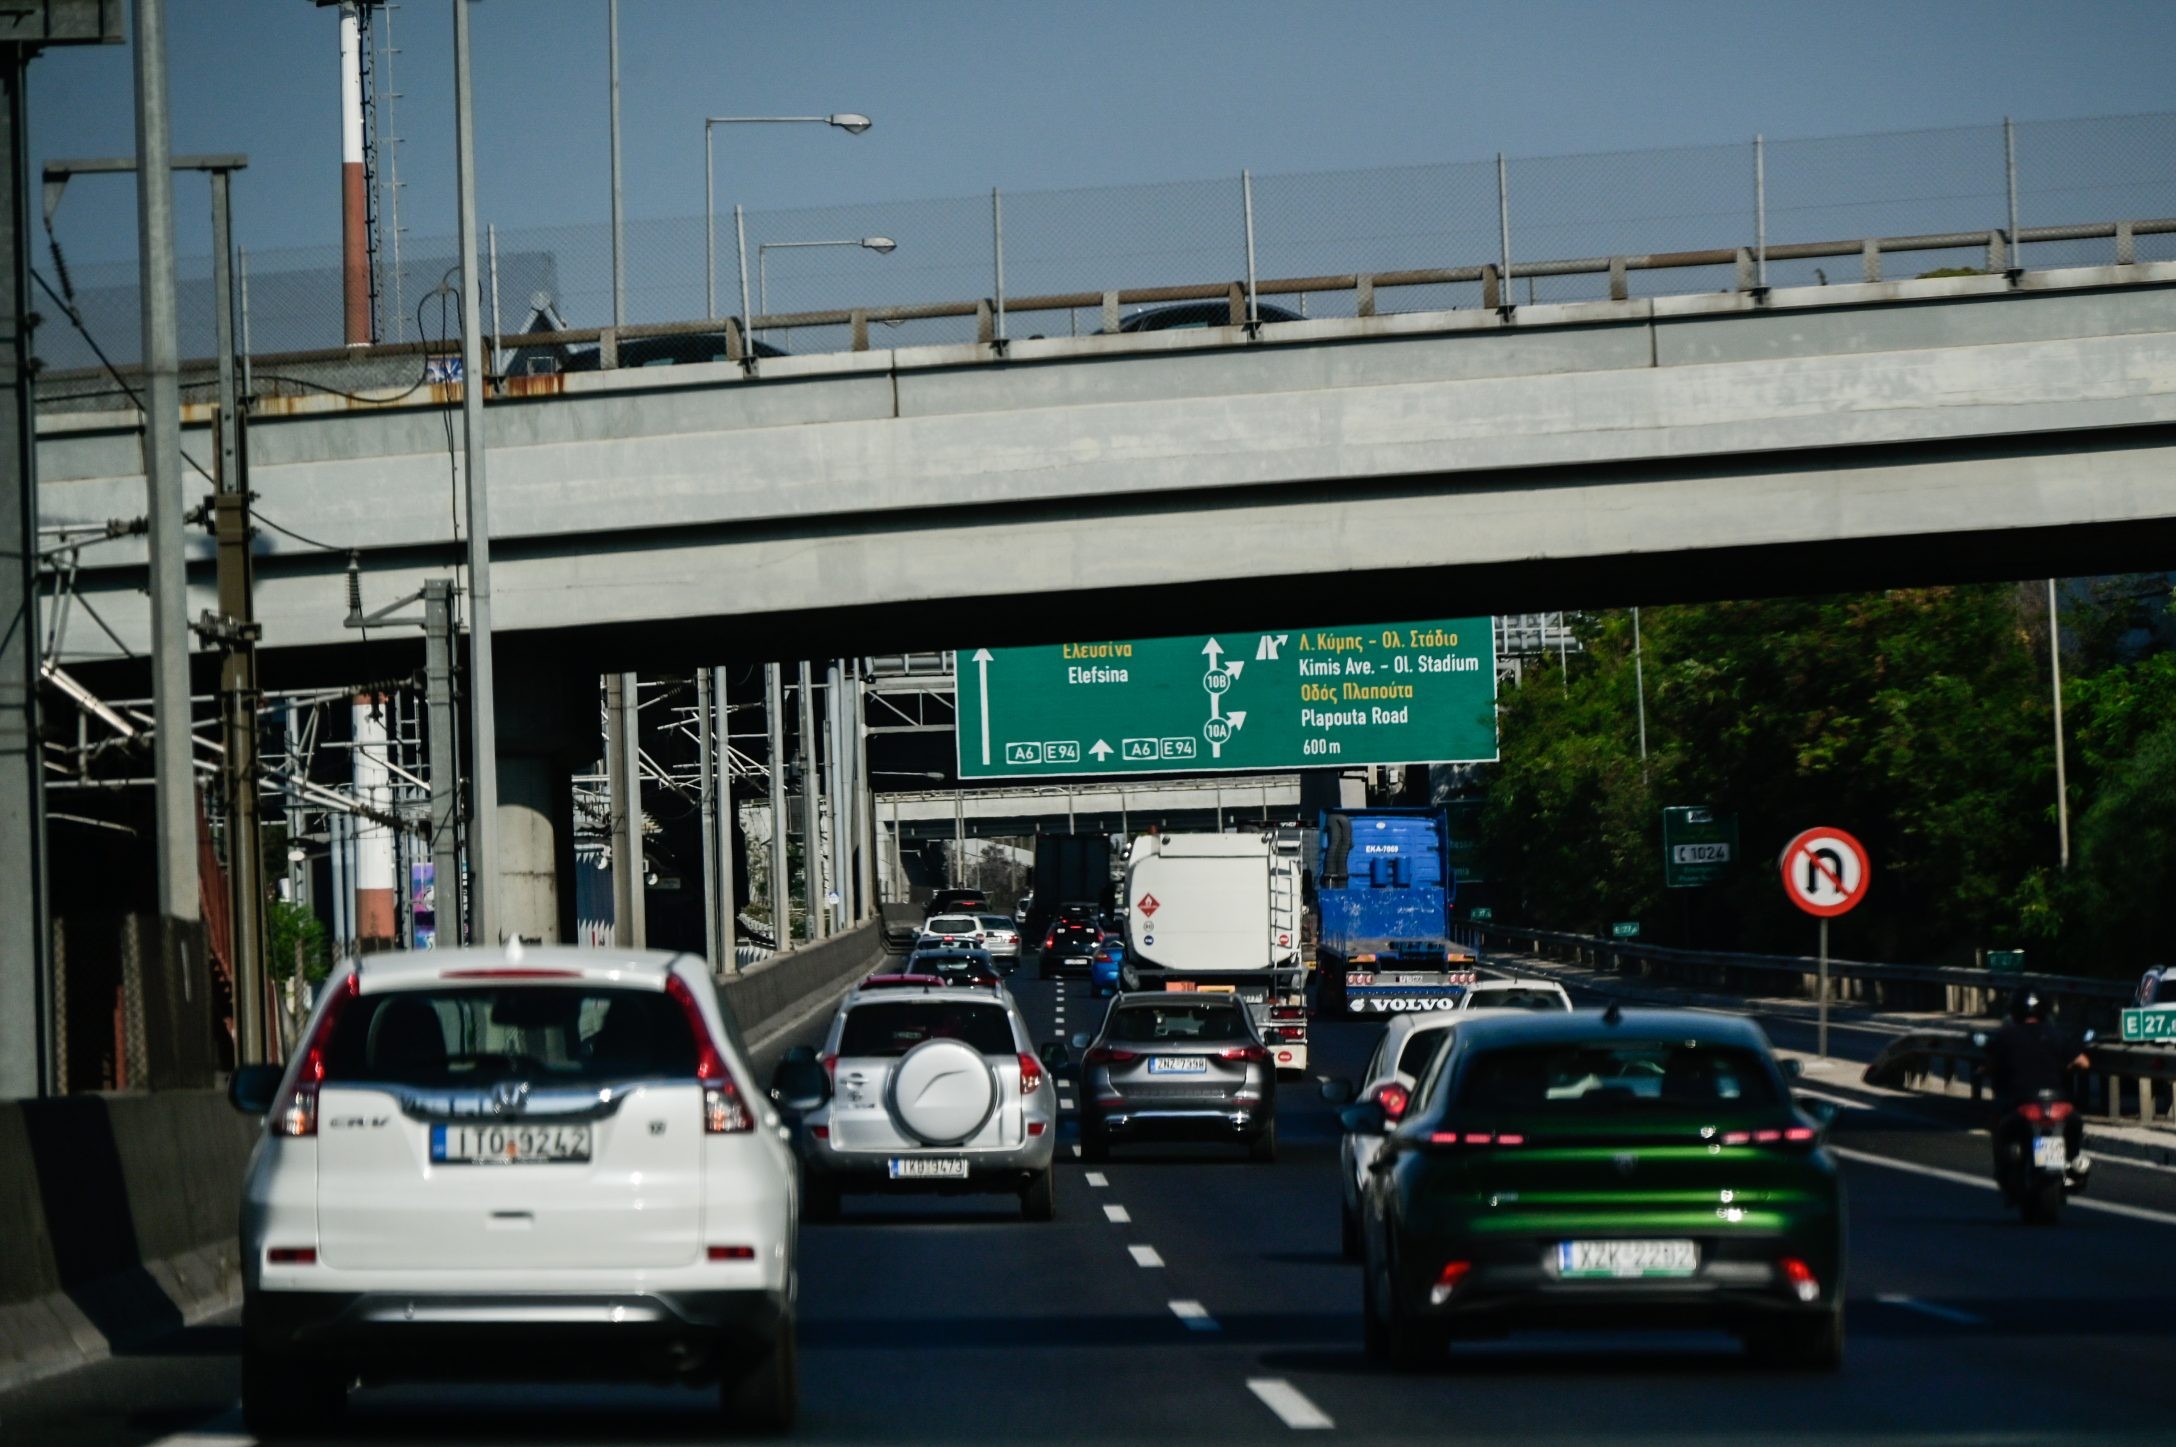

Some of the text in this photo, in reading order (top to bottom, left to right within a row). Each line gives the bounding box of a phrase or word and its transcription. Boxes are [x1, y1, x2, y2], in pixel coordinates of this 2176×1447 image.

[1382, 630, 1405, 648] Ολ.
[1410, 629, 1458, 648] Στάδιο
[1299, 657, 1341, 676] Kimis
[1345, 657, 1375, 675] Ave.
[1394, 656, 1413, 673] Ol.
[1418, 653, 1479, 673] Stadium
[1068, 665, 1129, 684] Elefsina
[1207, 675, 1226, 688] 10B
[1301, 681, 1414, 704] Οδός Πλαπούτα
[1301, 705, 1409, 731] Plapouta Road
[1208, 724, 1227, 738] 10A
[1014, 747, 1034, 760] A6
[1131, 743, 1150, 756] A6
[1303, 738, 1327, 755] 600
[1691, 846, 1725, 860] 1024
[1370, 998, 1454, 1011] VOLVO
[2126, 1016, 2138, 1034] E
